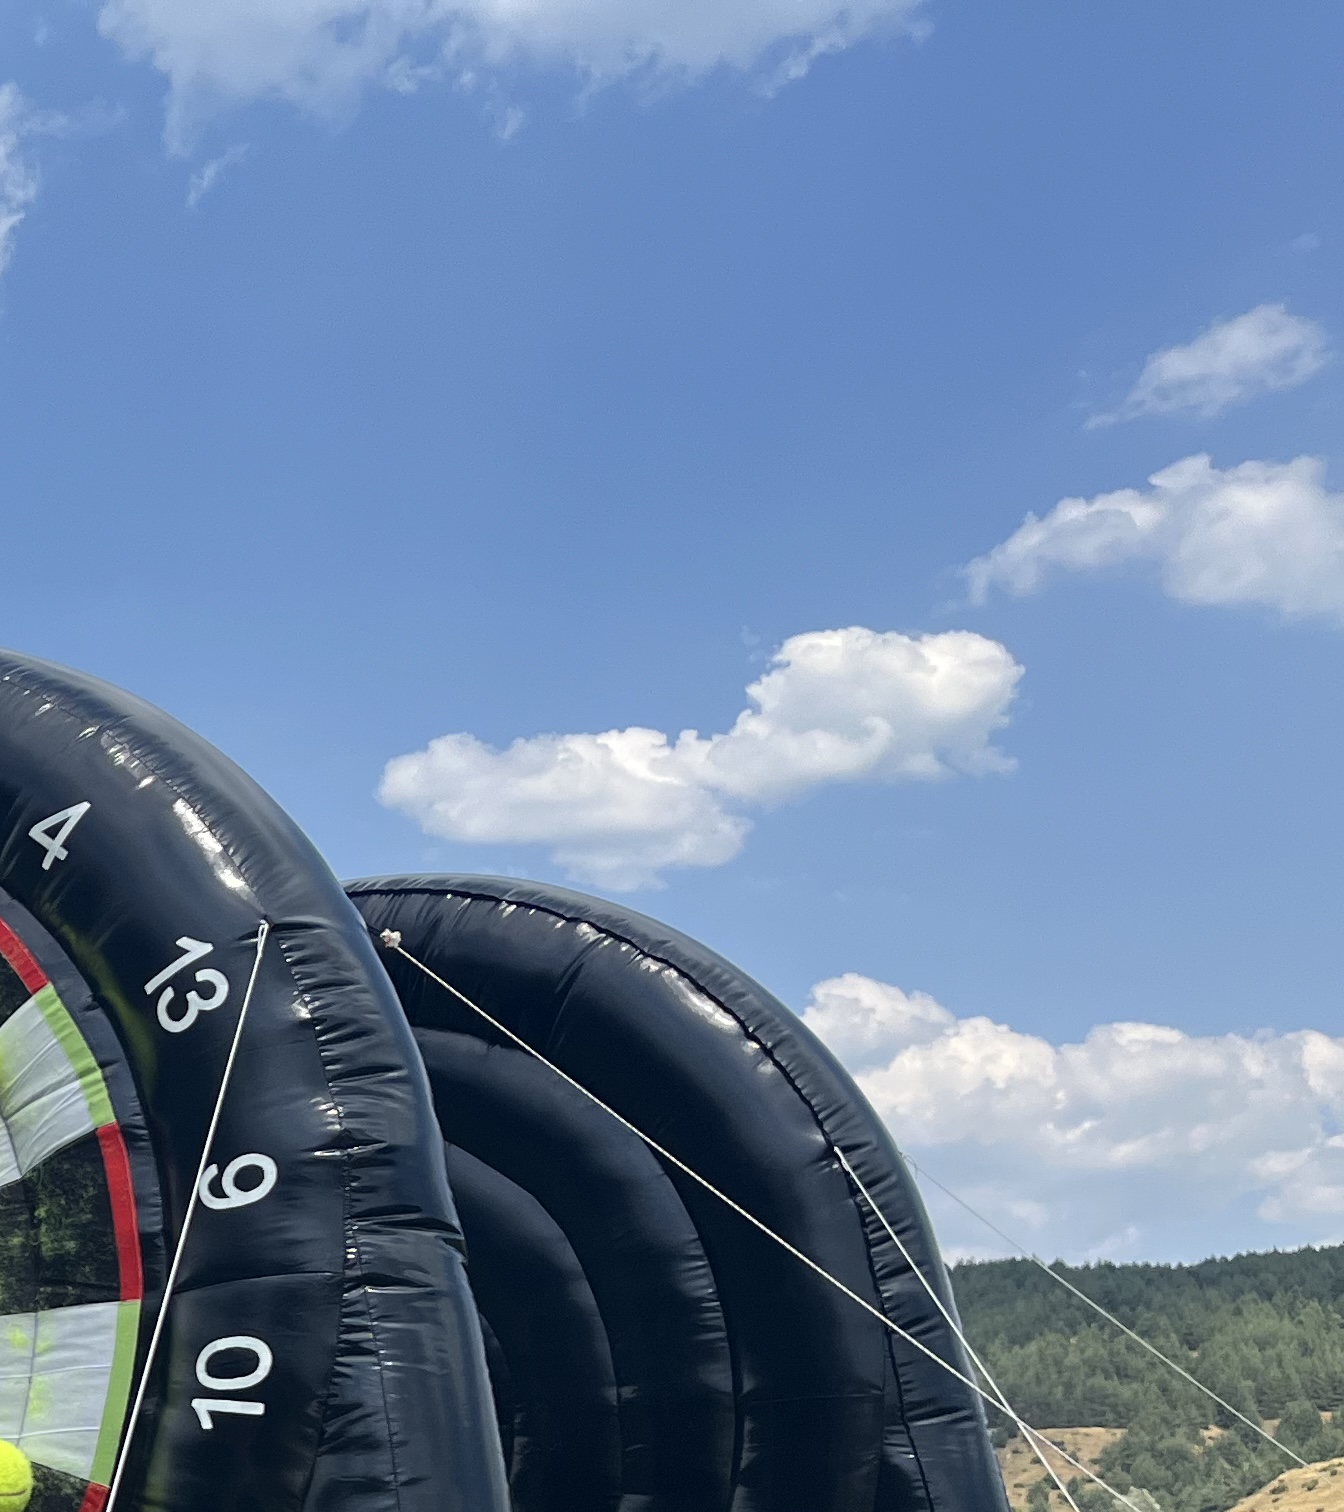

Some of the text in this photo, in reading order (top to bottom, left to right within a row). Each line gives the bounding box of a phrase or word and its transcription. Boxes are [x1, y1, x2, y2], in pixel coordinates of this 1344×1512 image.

[29, 800, 91, 870] 4
[144, 936, 230, 1034] 13
[192, 1335, 272, 1430] 10
